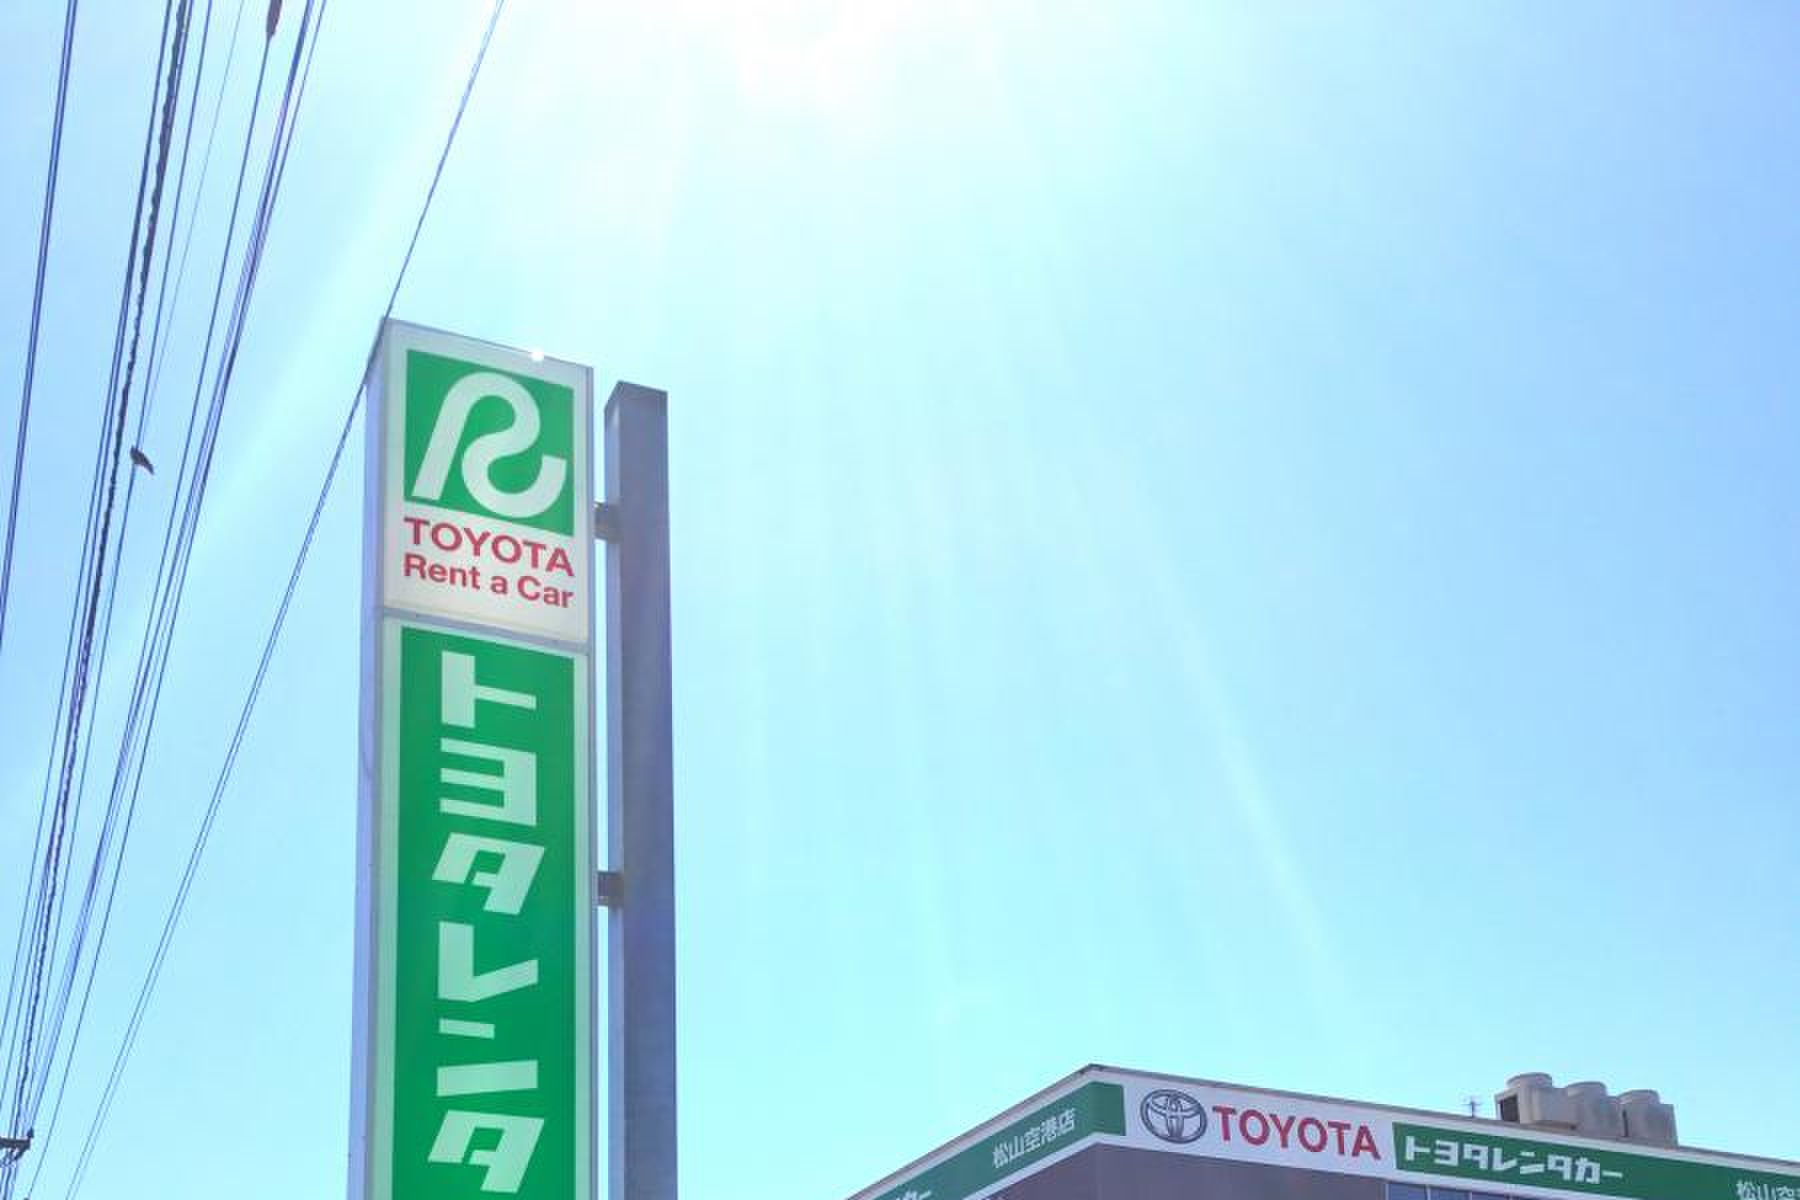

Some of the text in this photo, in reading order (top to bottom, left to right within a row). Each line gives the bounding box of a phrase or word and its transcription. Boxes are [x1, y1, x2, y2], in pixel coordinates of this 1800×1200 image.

[403, 515, 575, 577] TOYOTA
[403, 551, 575, 608] Rent a Car
[993, 1107, 1075, 1169] 松山空港店
[1212, 1104, 1382, 1161] TOYOTA
[1404, 1135, 1624, 1185] トヨタレンタカー
